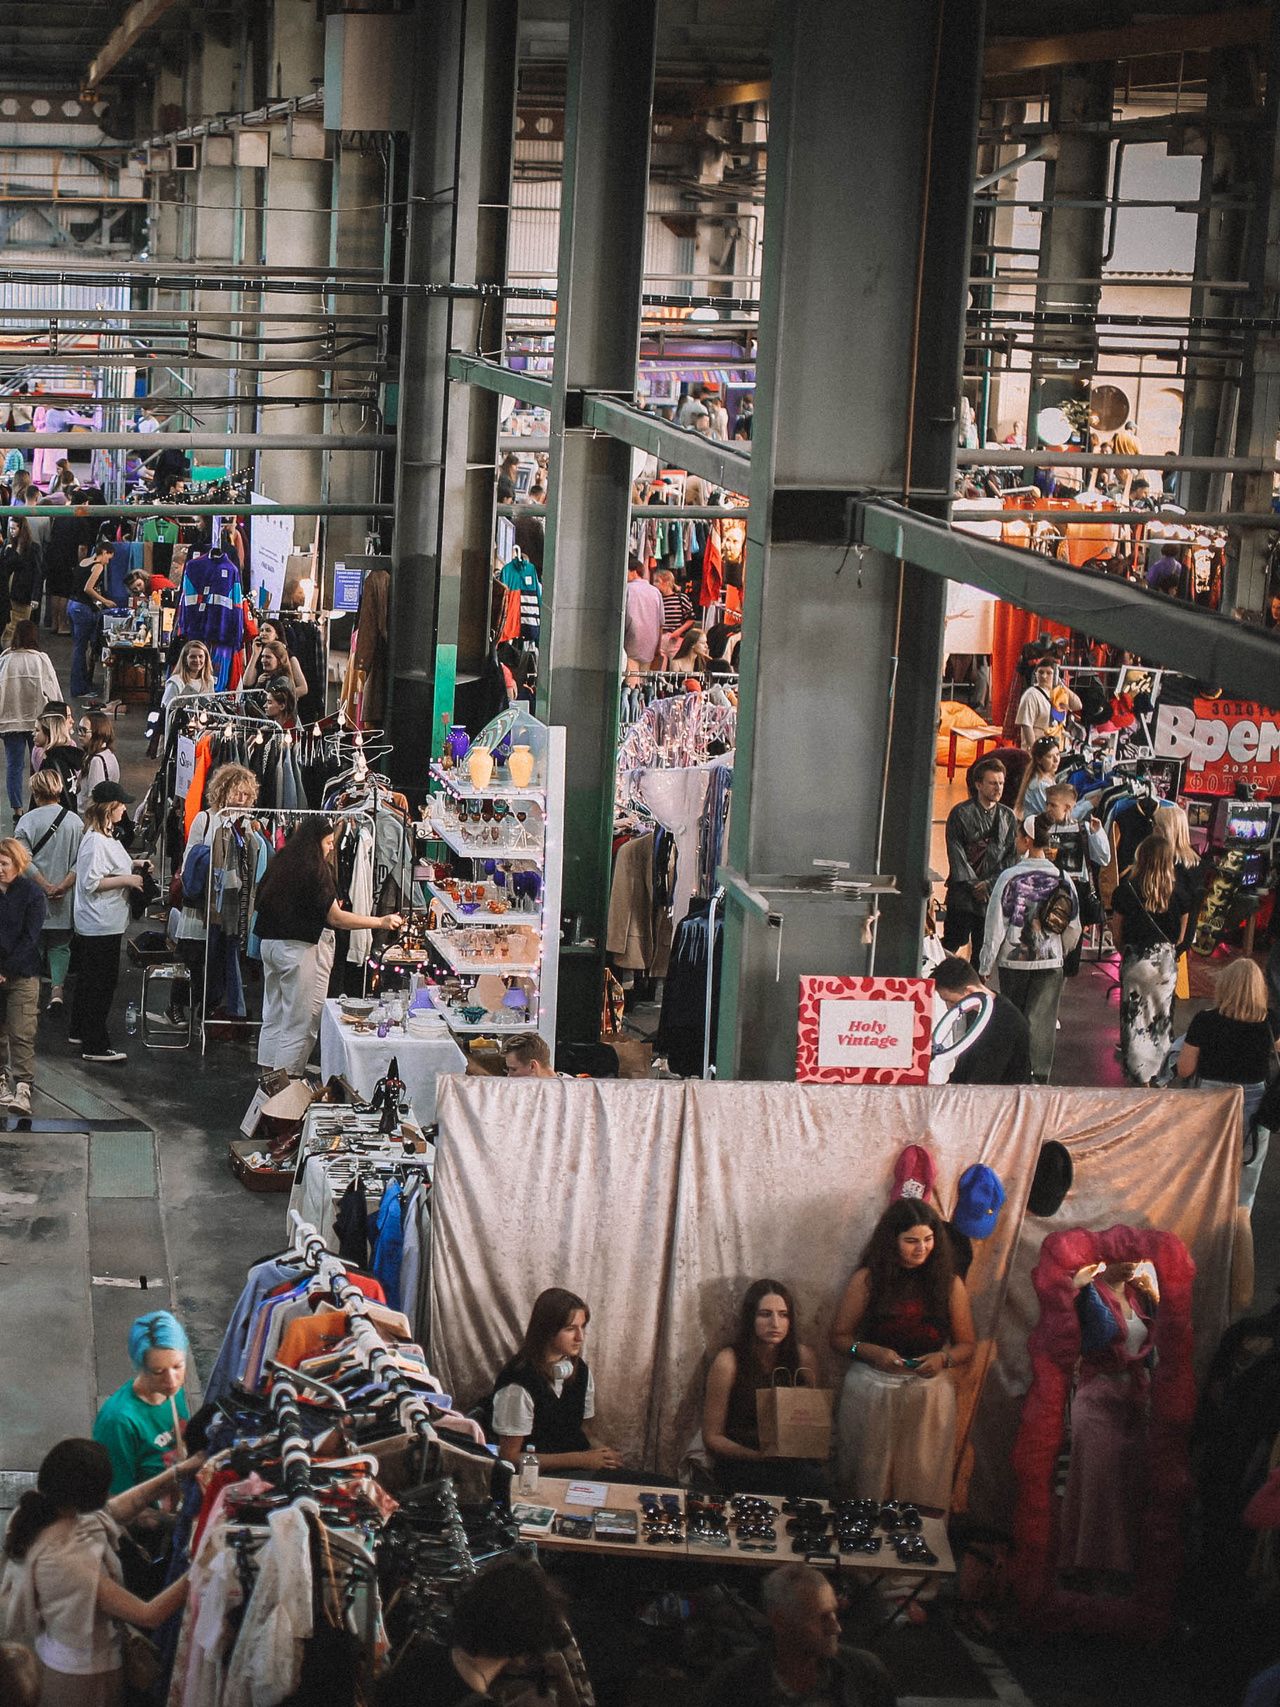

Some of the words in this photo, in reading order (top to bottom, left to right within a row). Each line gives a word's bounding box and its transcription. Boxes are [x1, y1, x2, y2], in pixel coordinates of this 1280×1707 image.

[1223, 764, 1259, 774] 2021
[848, 1020, 886, 1035] Holy
[837, 1034, 899, 1050] Vintage
